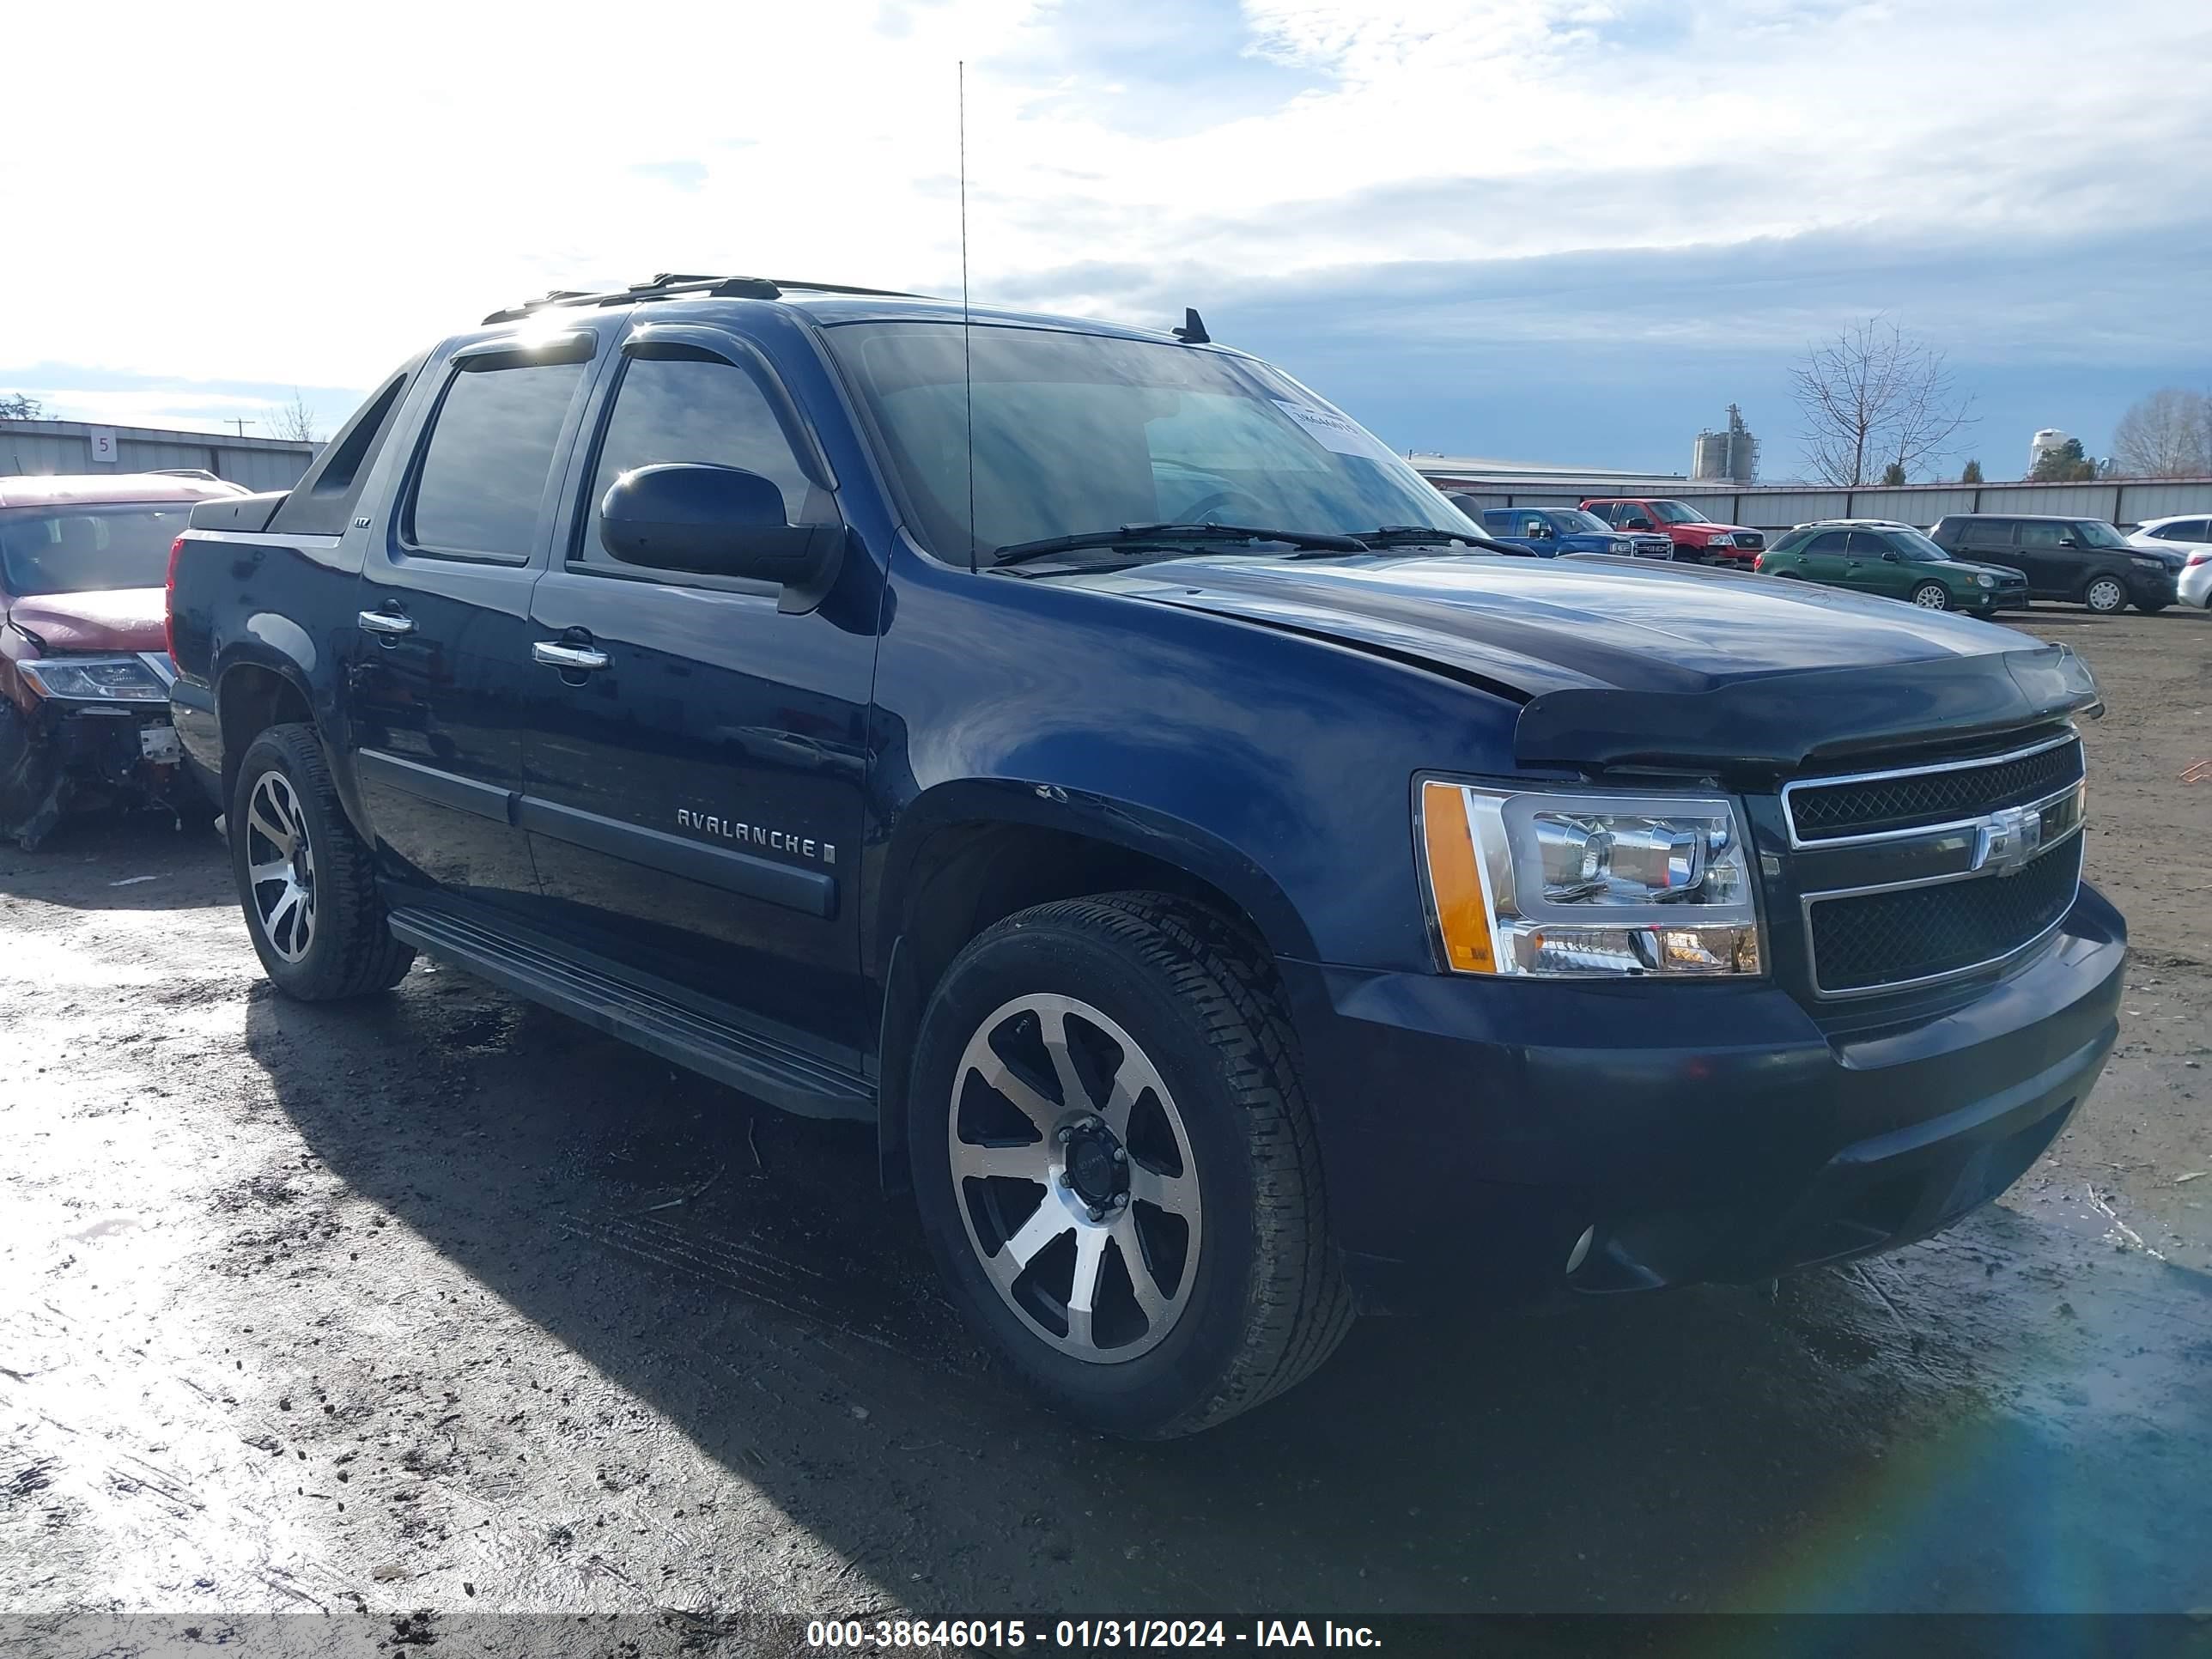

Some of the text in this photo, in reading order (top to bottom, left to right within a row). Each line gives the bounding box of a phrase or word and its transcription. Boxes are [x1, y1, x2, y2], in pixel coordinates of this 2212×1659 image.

[99, 437, 109, 453] 5
[354, 516, 371, 529] LTZ
[677, 808, 816, 858] AVALANCHE
